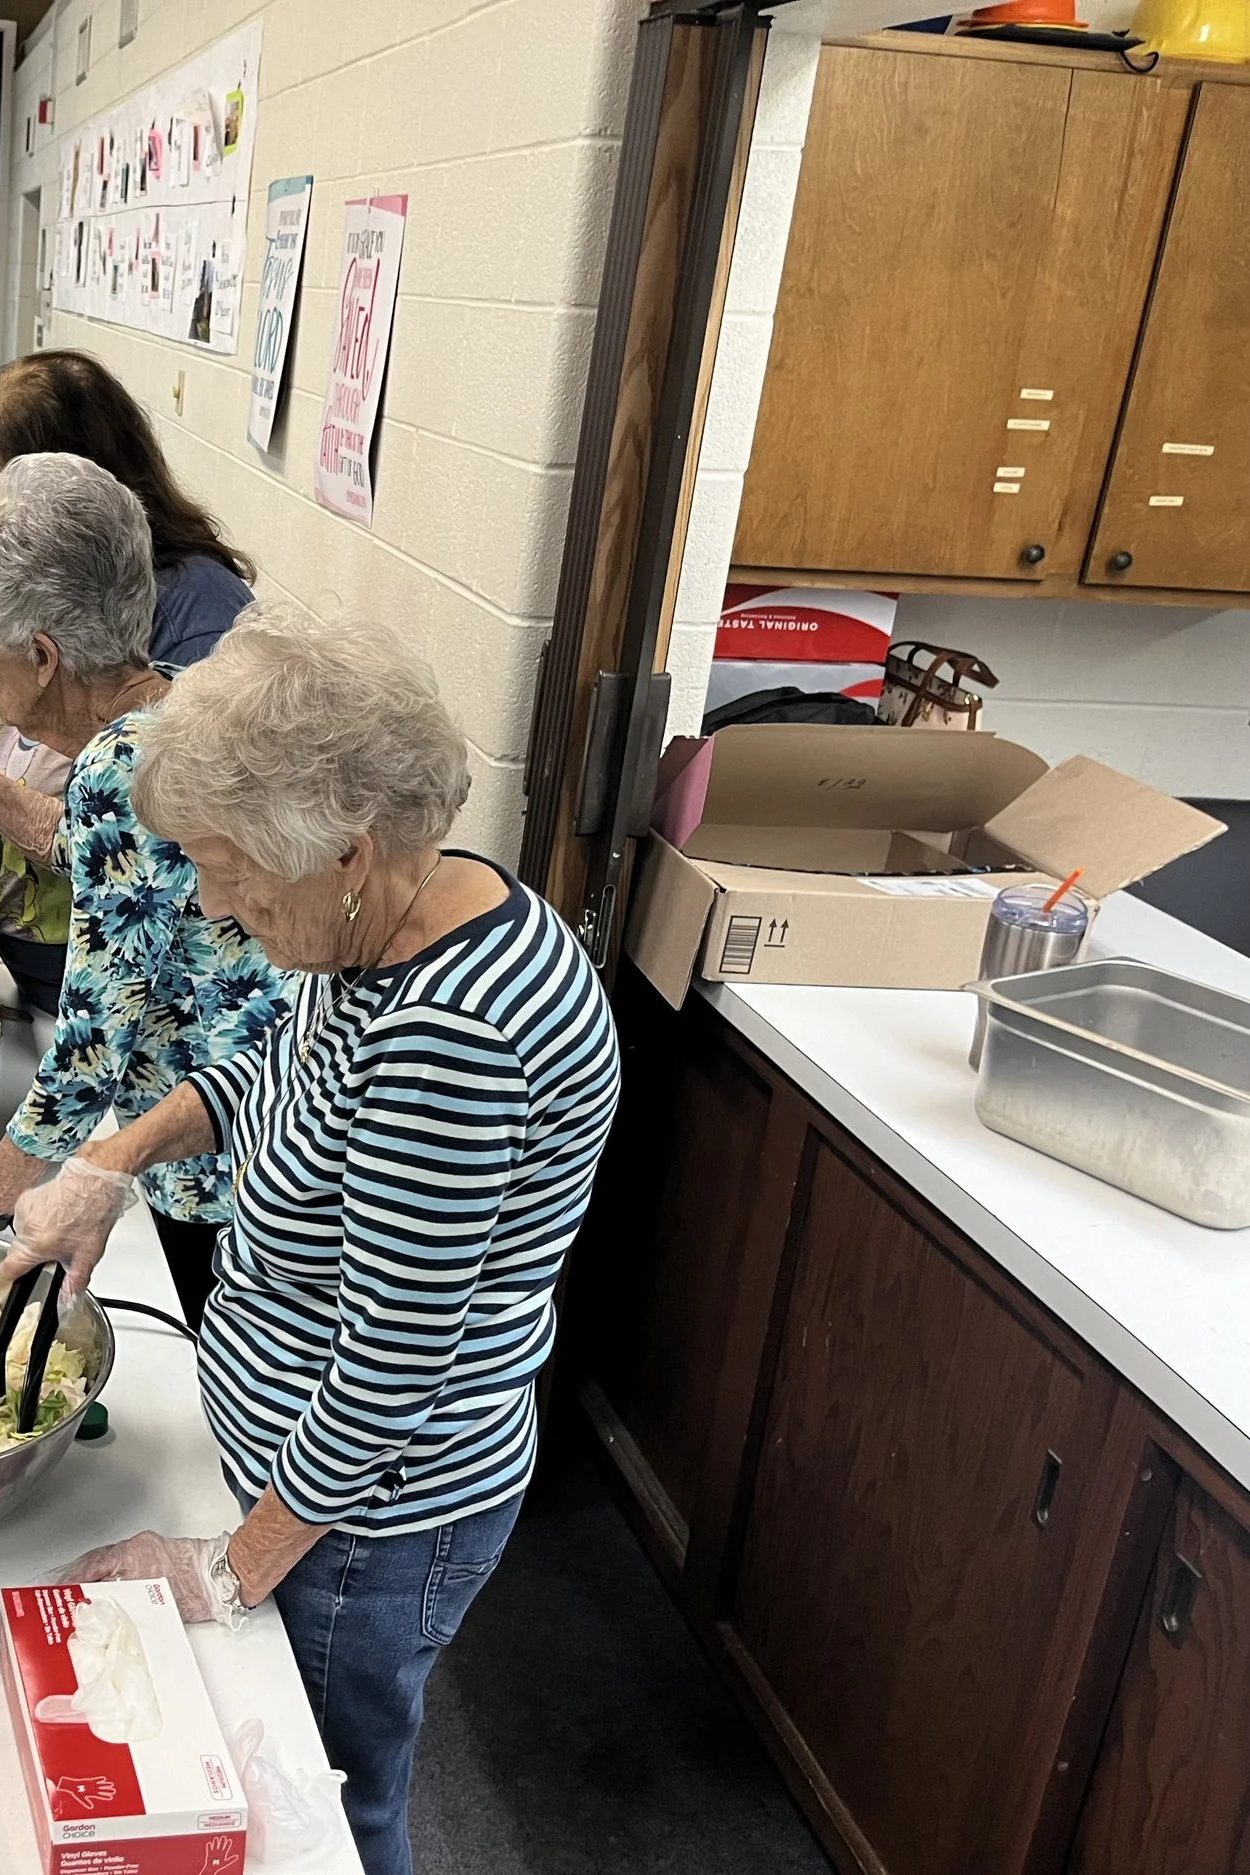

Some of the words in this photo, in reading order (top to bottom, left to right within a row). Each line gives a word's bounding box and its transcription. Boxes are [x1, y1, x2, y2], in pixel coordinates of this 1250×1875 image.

[759, 620, 819, 631] ORIGINAL
[215, 1765, 227, 1789] MEDIUM
[62, 1824, 96, 1832] Gordon
[61, 1851, 81, 1860] Vinyl
[81, 1850, 107, 1858] Gloves
[60, 1859, 91, 1867] Guantes
